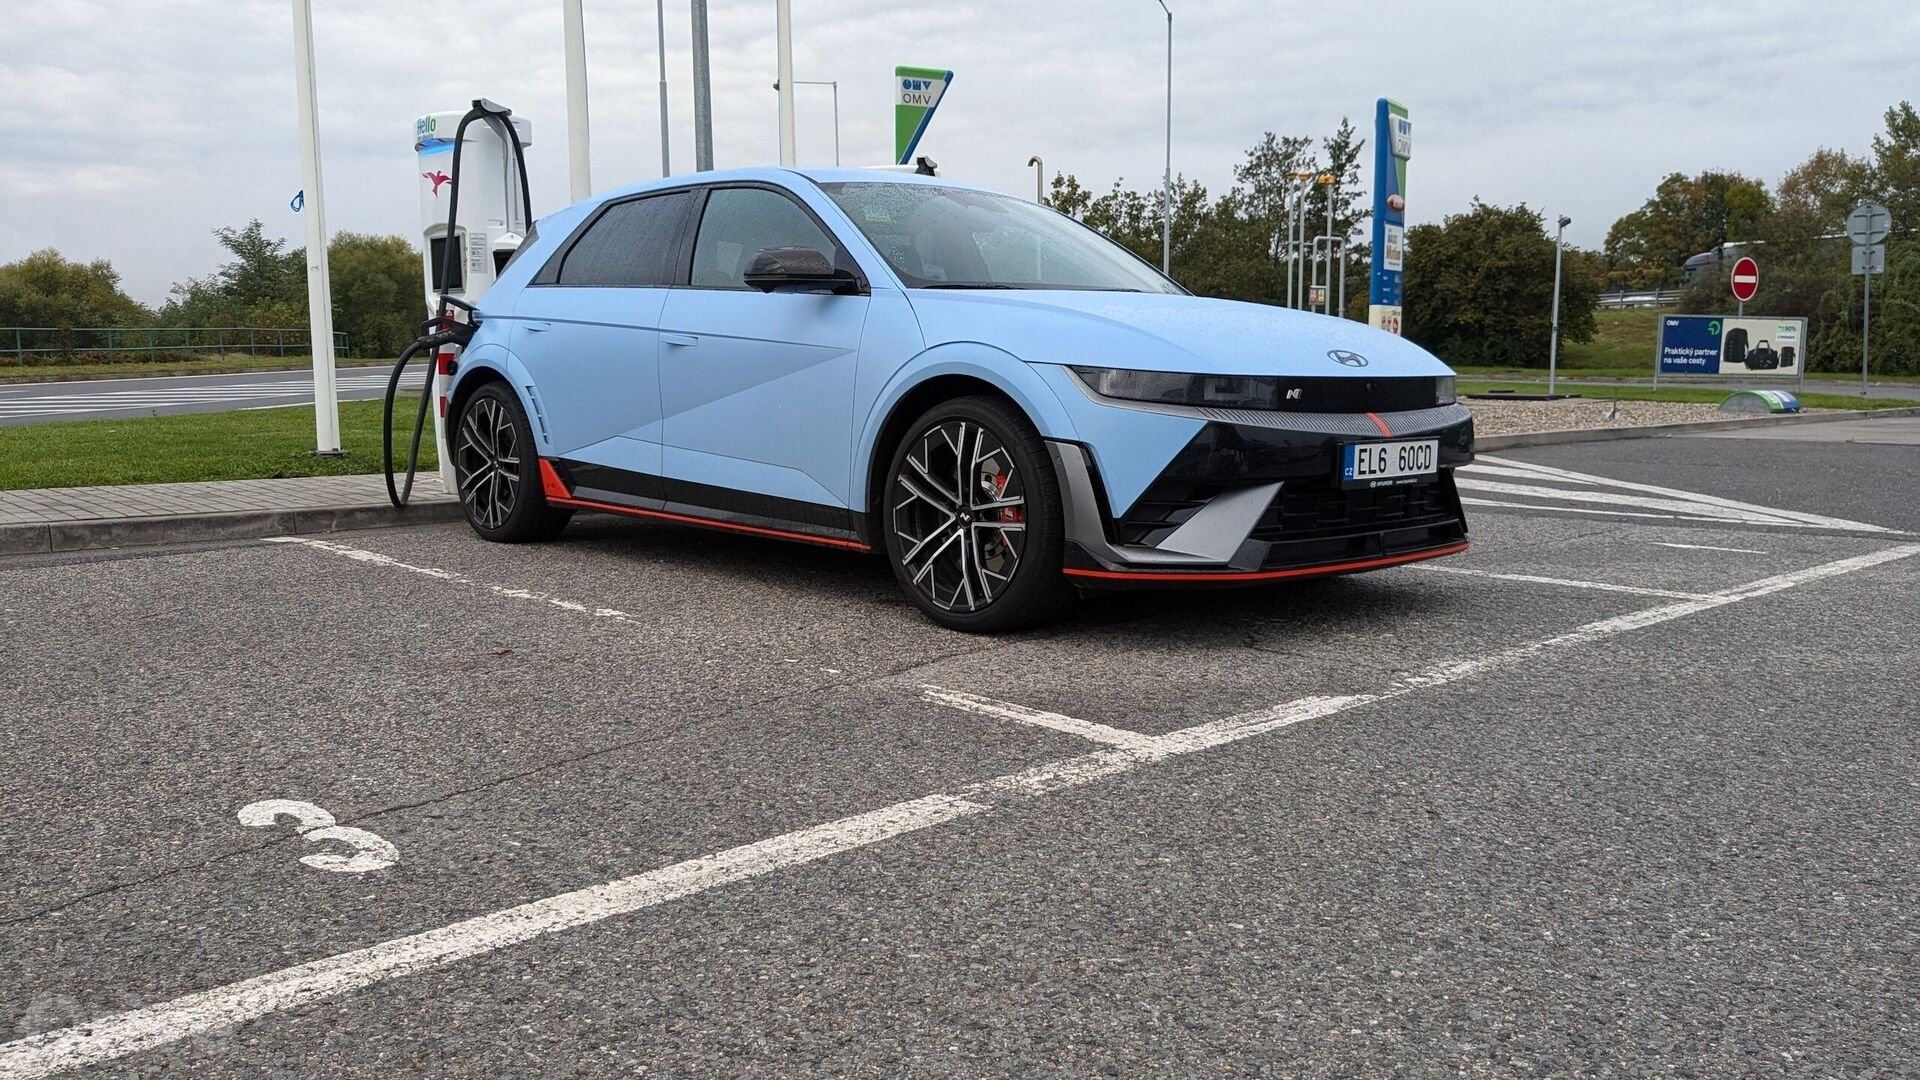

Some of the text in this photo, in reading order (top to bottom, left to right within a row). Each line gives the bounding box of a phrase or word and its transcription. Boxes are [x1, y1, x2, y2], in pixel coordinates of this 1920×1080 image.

[902, 93, 932, 105] OMV
[417, 115, 436, 136] Hello
[1664, 346, 1693, 356] Praktický
[1673, 356, 1687, 364] vaše
[1688, 357, 1706, 366] cesty
[1344, 467, 1353, 476] CZ
[1357, 447, 1388, 475] EL6
[237, 798, 400, 873] 3
